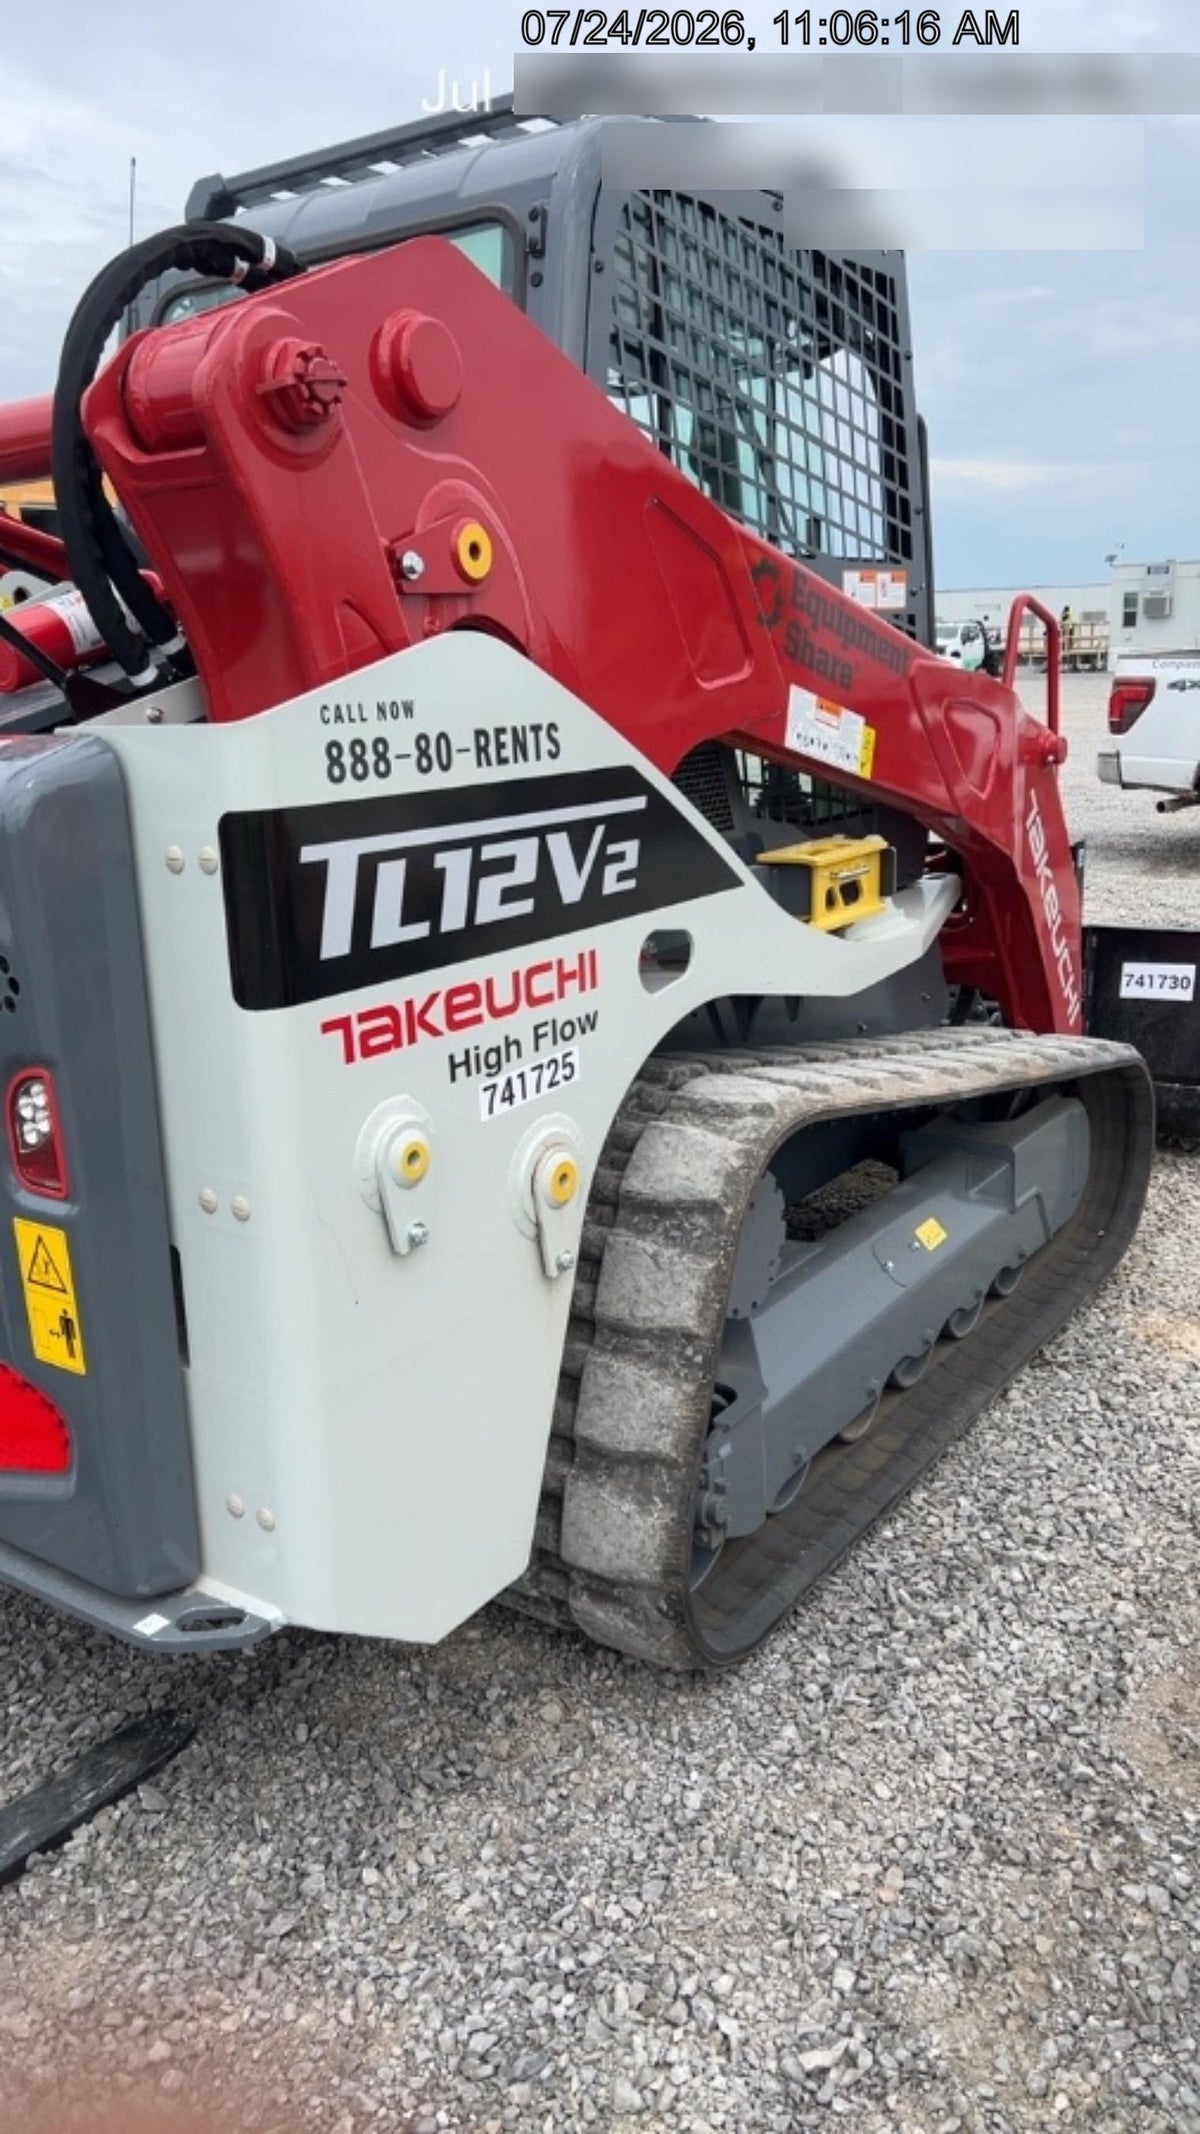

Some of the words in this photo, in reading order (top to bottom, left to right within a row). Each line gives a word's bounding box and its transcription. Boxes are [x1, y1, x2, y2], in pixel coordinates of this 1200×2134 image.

[784, 619, 854, 691] Share
[320, 703, 368, 725] CALL
[376, 699, 415, 721] NOW
[324, 721, 562, 784] 888-80-RENTS
[300, 795, 648, 961] TL12V2
[1123, 972, 1192, 991] 741730
[448, 1034, 523, 1083] High
[532, 1009, 600, 1053] Flow
[481, 1050, 576, 1116] 741725
